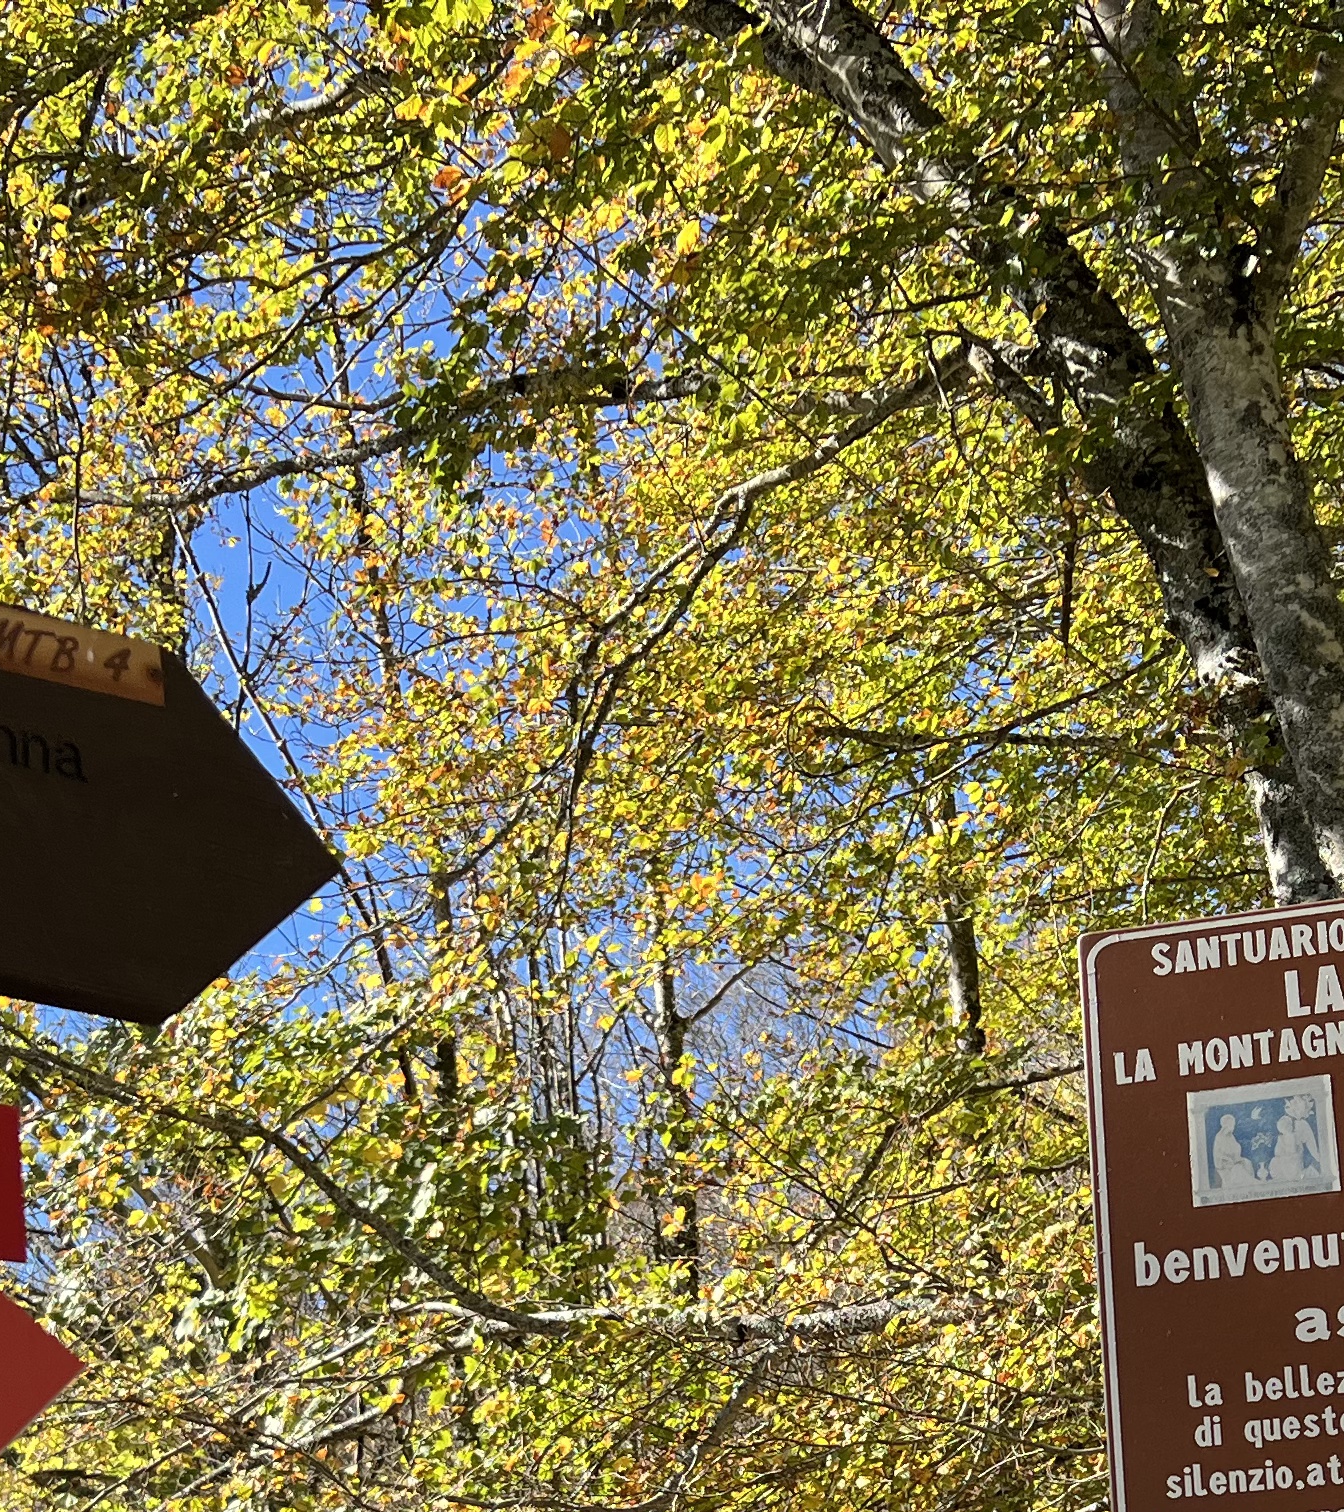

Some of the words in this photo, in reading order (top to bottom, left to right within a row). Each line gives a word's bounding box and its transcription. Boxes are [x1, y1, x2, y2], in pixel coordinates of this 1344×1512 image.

[104, 648, 132, 682] 4
[1112, 1047, 1157, 1086] LA
[1187, 1374, 1224, 1408] la
[1194, 1415, 1222, 1448] di
